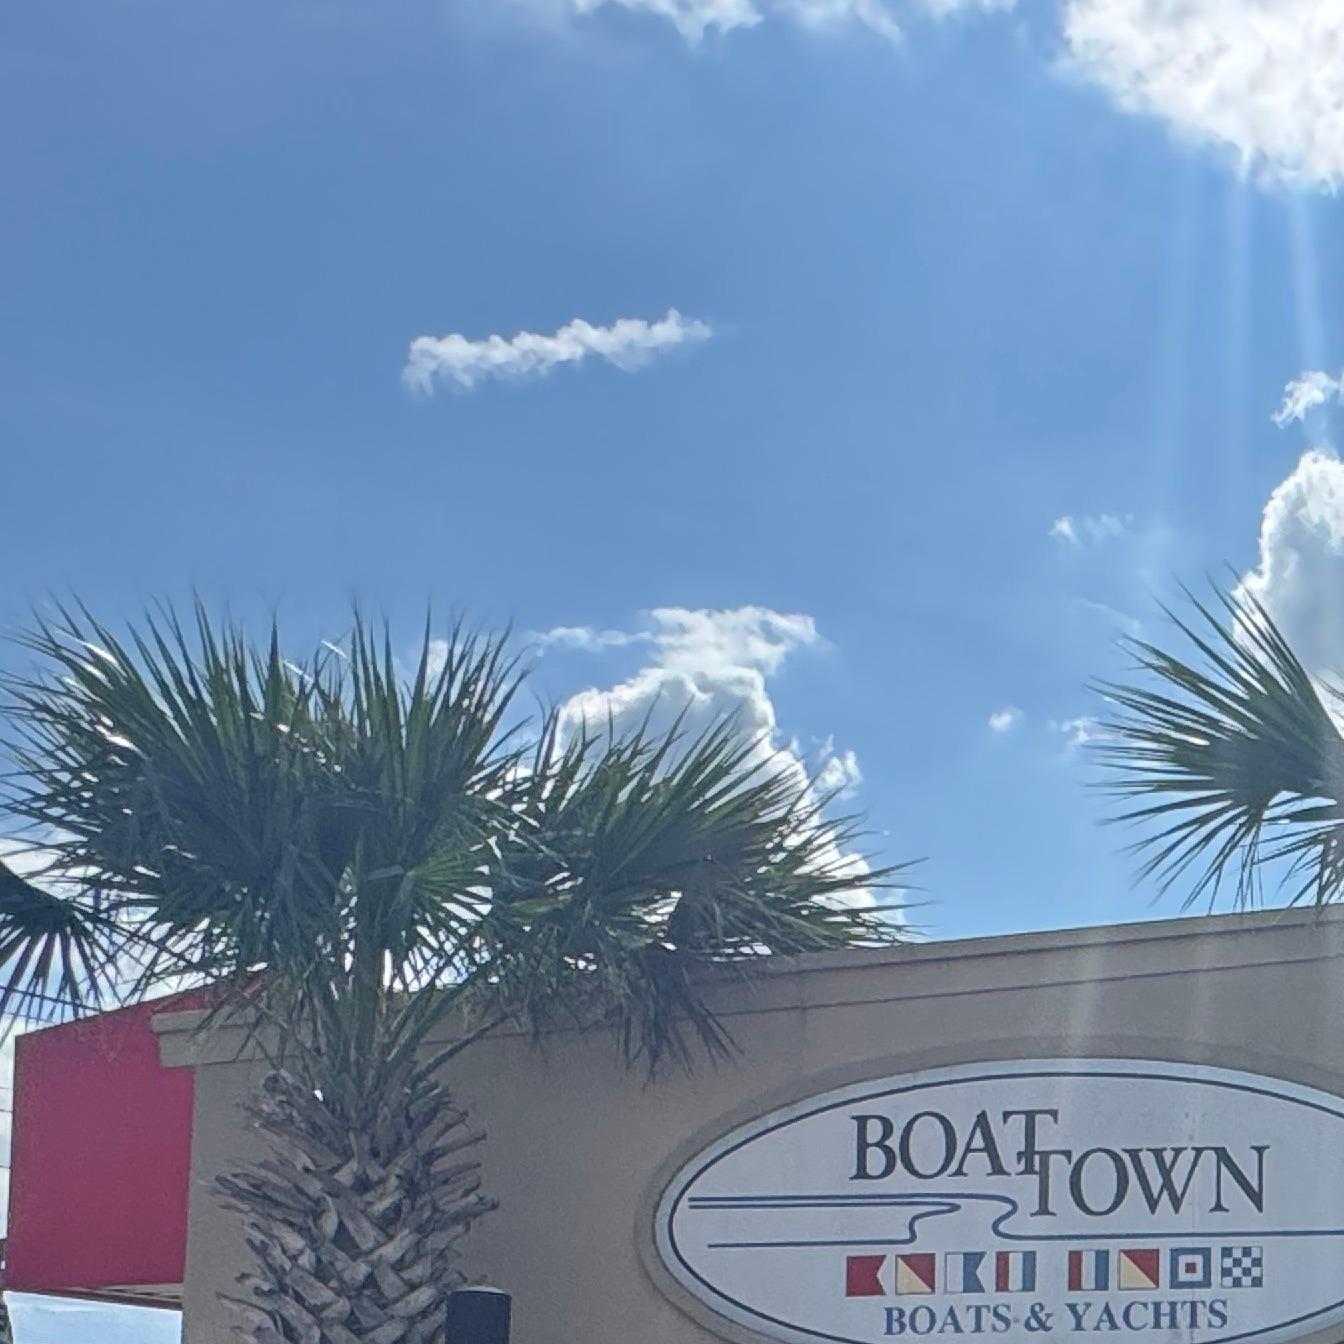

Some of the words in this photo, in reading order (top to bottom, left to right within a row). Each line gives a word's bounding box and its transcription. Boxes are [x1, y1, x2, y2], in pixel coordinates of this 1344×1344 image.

[849, 1109, 1059, 1181] BOAT
[1016, 1144, 1271, 1218] TOWN
[883, 1303, 1012, 1336] BOATS
[1023, 1302, 1054, 1333] &
[1064, 1299, 1229, 1332] YACHTS
